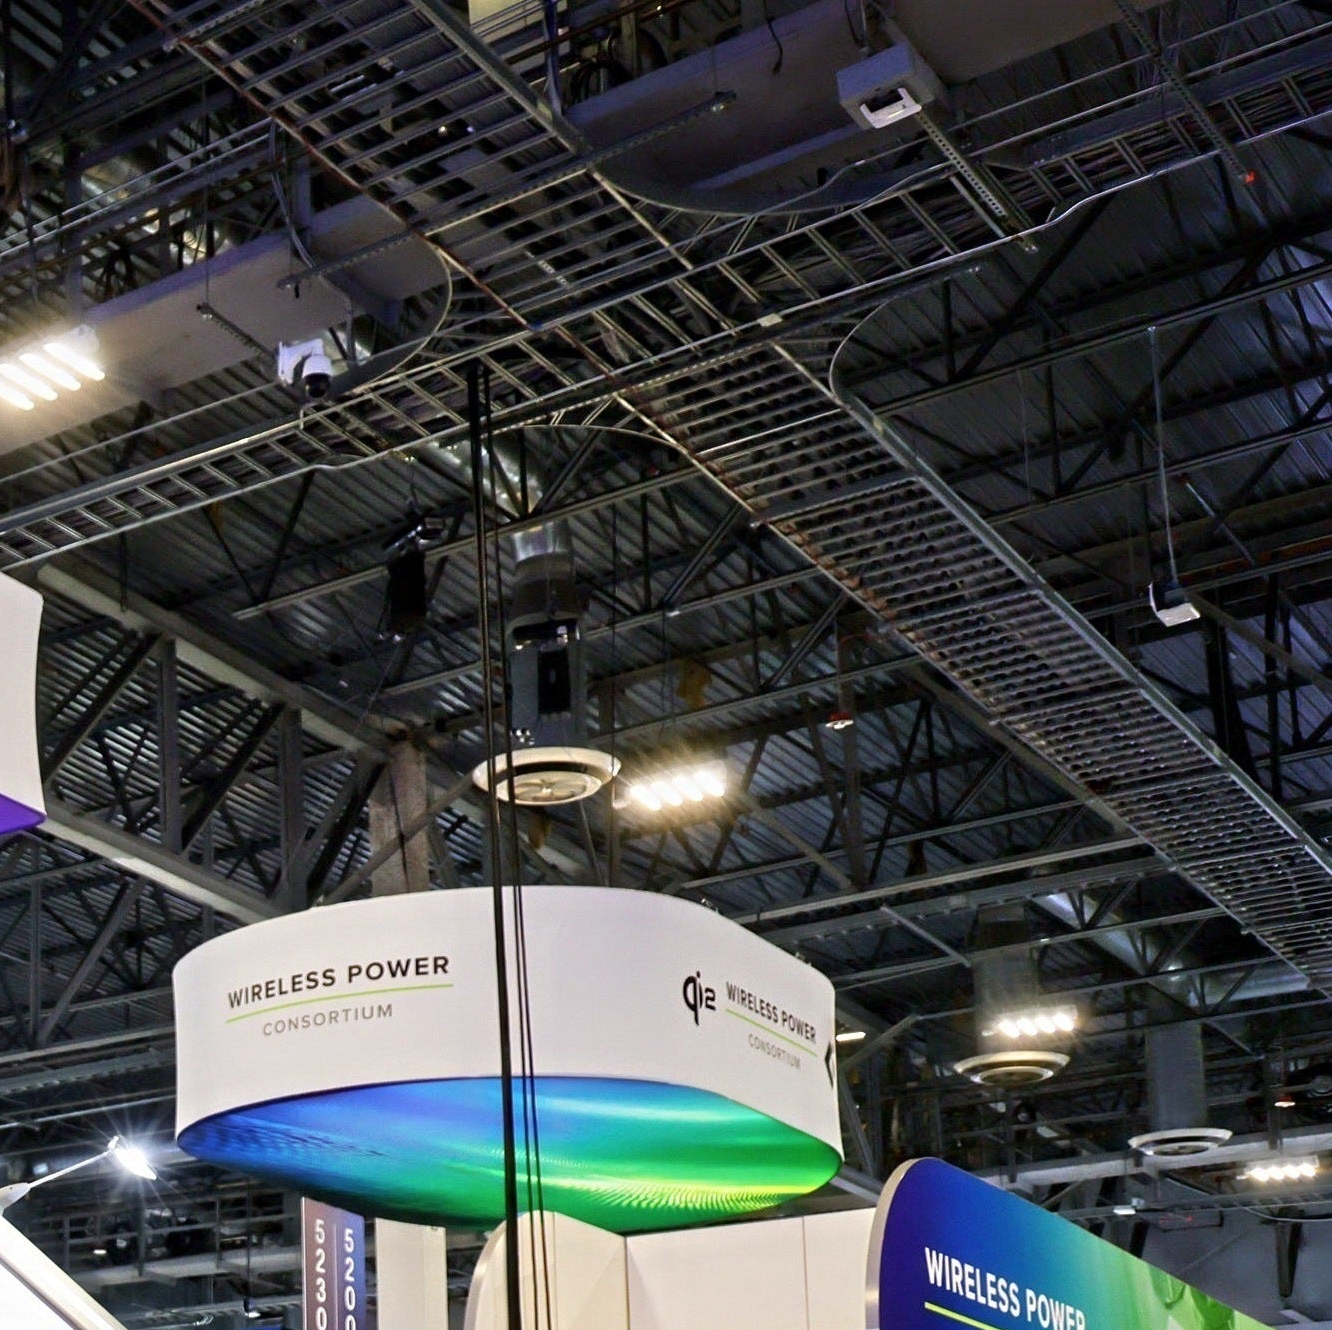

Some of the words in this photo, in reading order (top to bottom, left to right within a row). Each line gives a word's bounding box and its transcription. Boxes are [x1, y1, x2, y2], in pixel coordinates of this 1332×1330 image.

[227, 967, 336, 1009] WIRELESS
[348, 954, 450, 984] POWER
[262, 1003, 394, 1037] CONSORTIUM
[726, 980, 779, 1024] WIRELESS
[782, 1010, 817, 1044] POWER
[747, 1033, 801, 1070] CONSORTIUM
[924, 1246, 1020, 1320] WIRELESS
